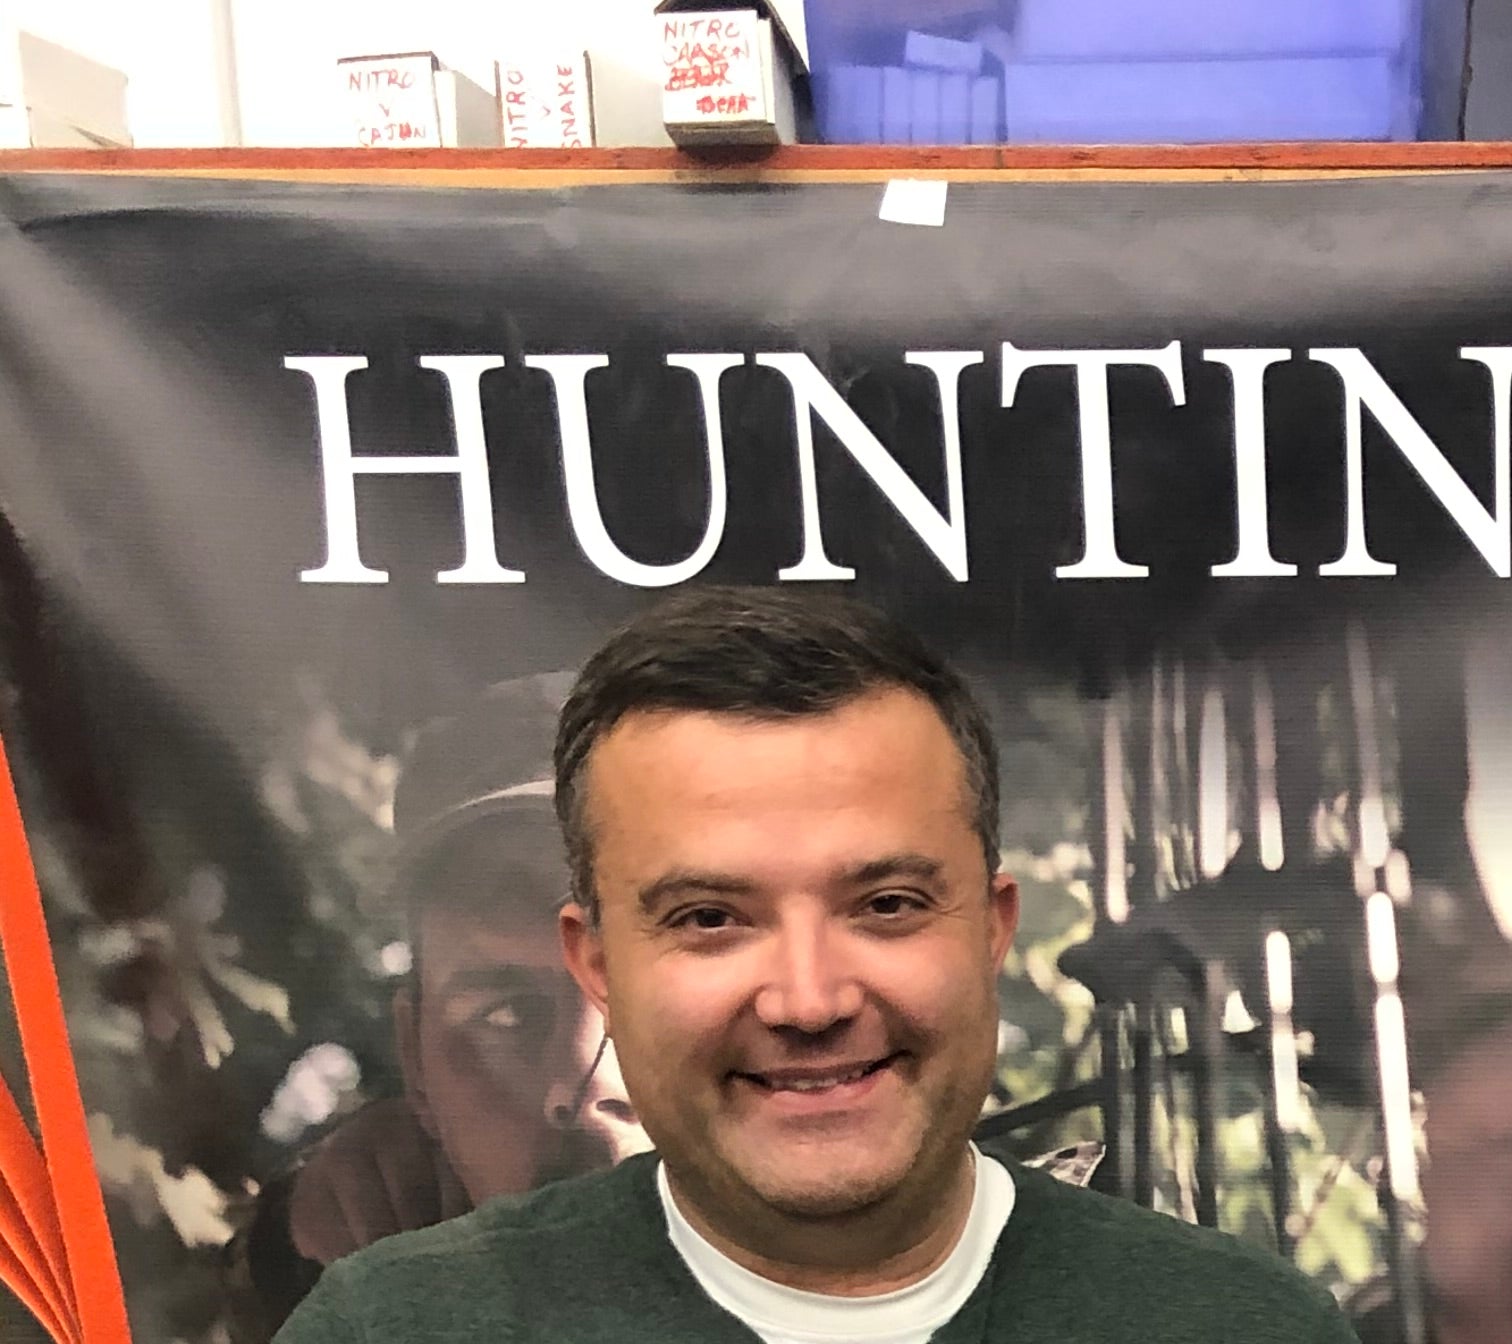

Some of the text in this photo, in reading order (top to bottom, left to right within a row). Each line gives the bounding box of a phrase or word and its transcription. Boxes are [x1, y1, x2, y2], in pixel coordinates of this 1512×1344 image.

[348, 69, 417, 91] NITRO
[506, 69, 529, 150] NITRO
[556, 64, 583, 150] SNAKE
[358, 122, 427, 148] CAJUN
